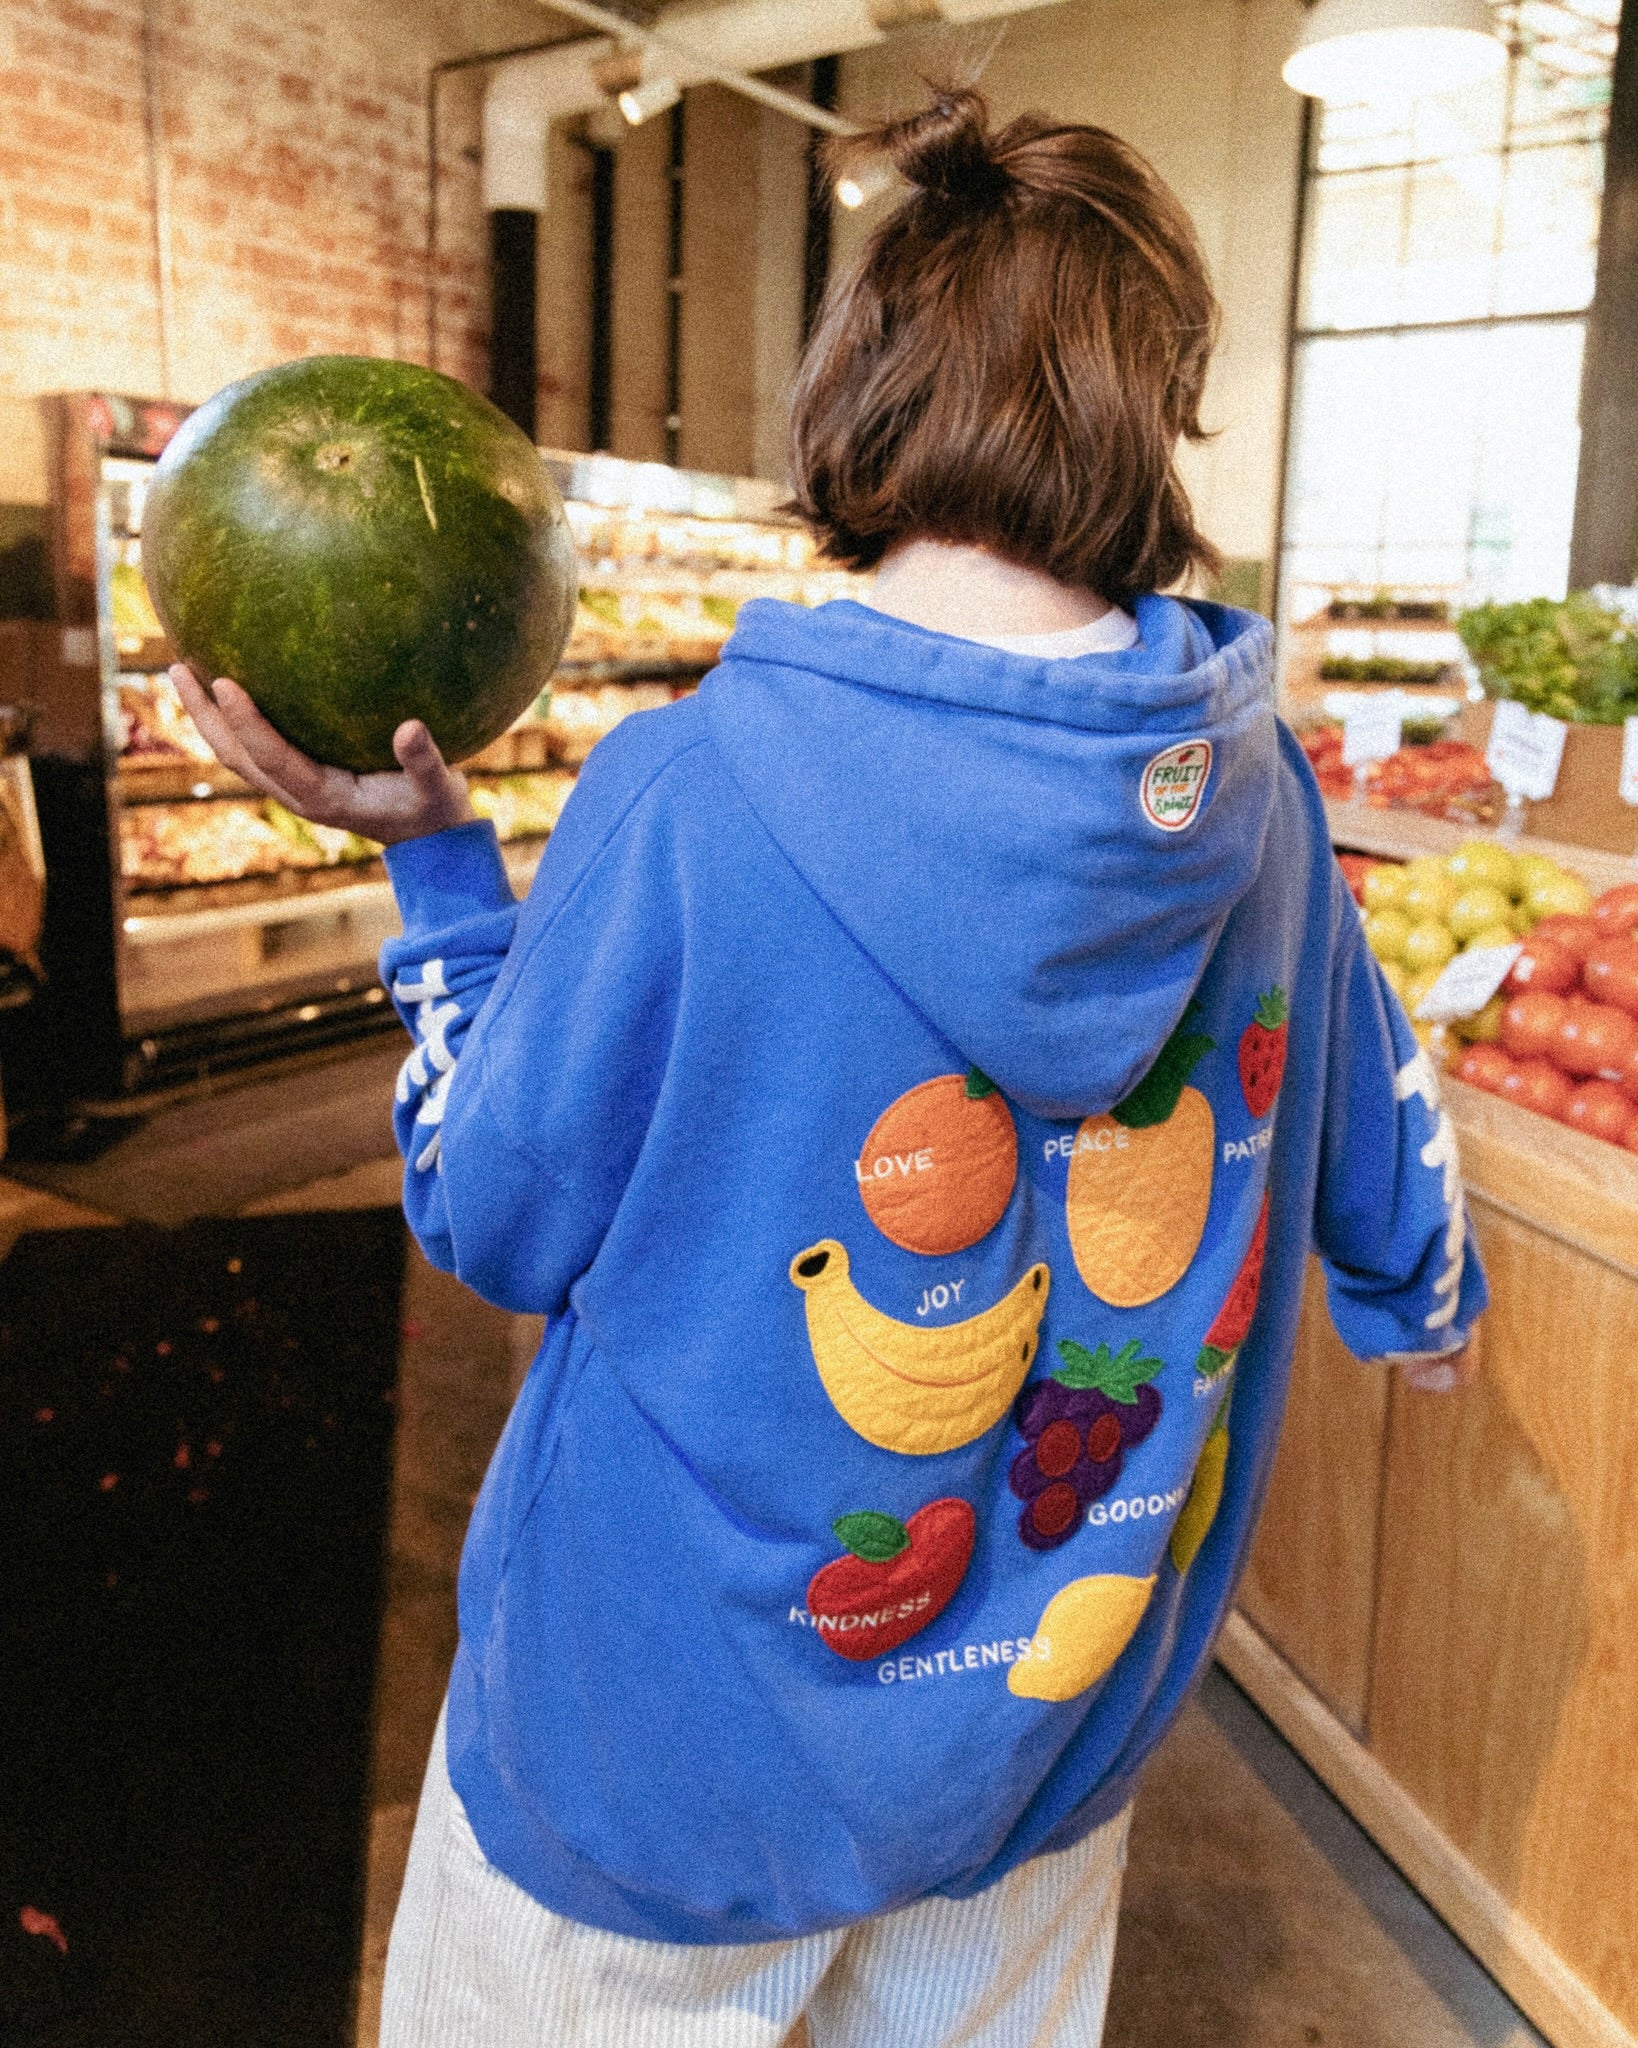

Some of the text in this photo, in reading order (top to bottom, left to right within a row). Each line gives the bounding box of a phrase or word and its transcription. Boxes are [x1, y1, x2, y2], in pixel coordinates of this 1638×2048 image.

[1152, 765, 1203, 784] FRUIT
[1044, 1126, 1130, 1163] PEACE
[854, 1147, 934, 1183] LOVE
[916, 1278, 965, 1316] JOY
[788, 1590, 932, 1632] KINDNESS
[878, 1635, 1053, 1684] GENTLENESS
